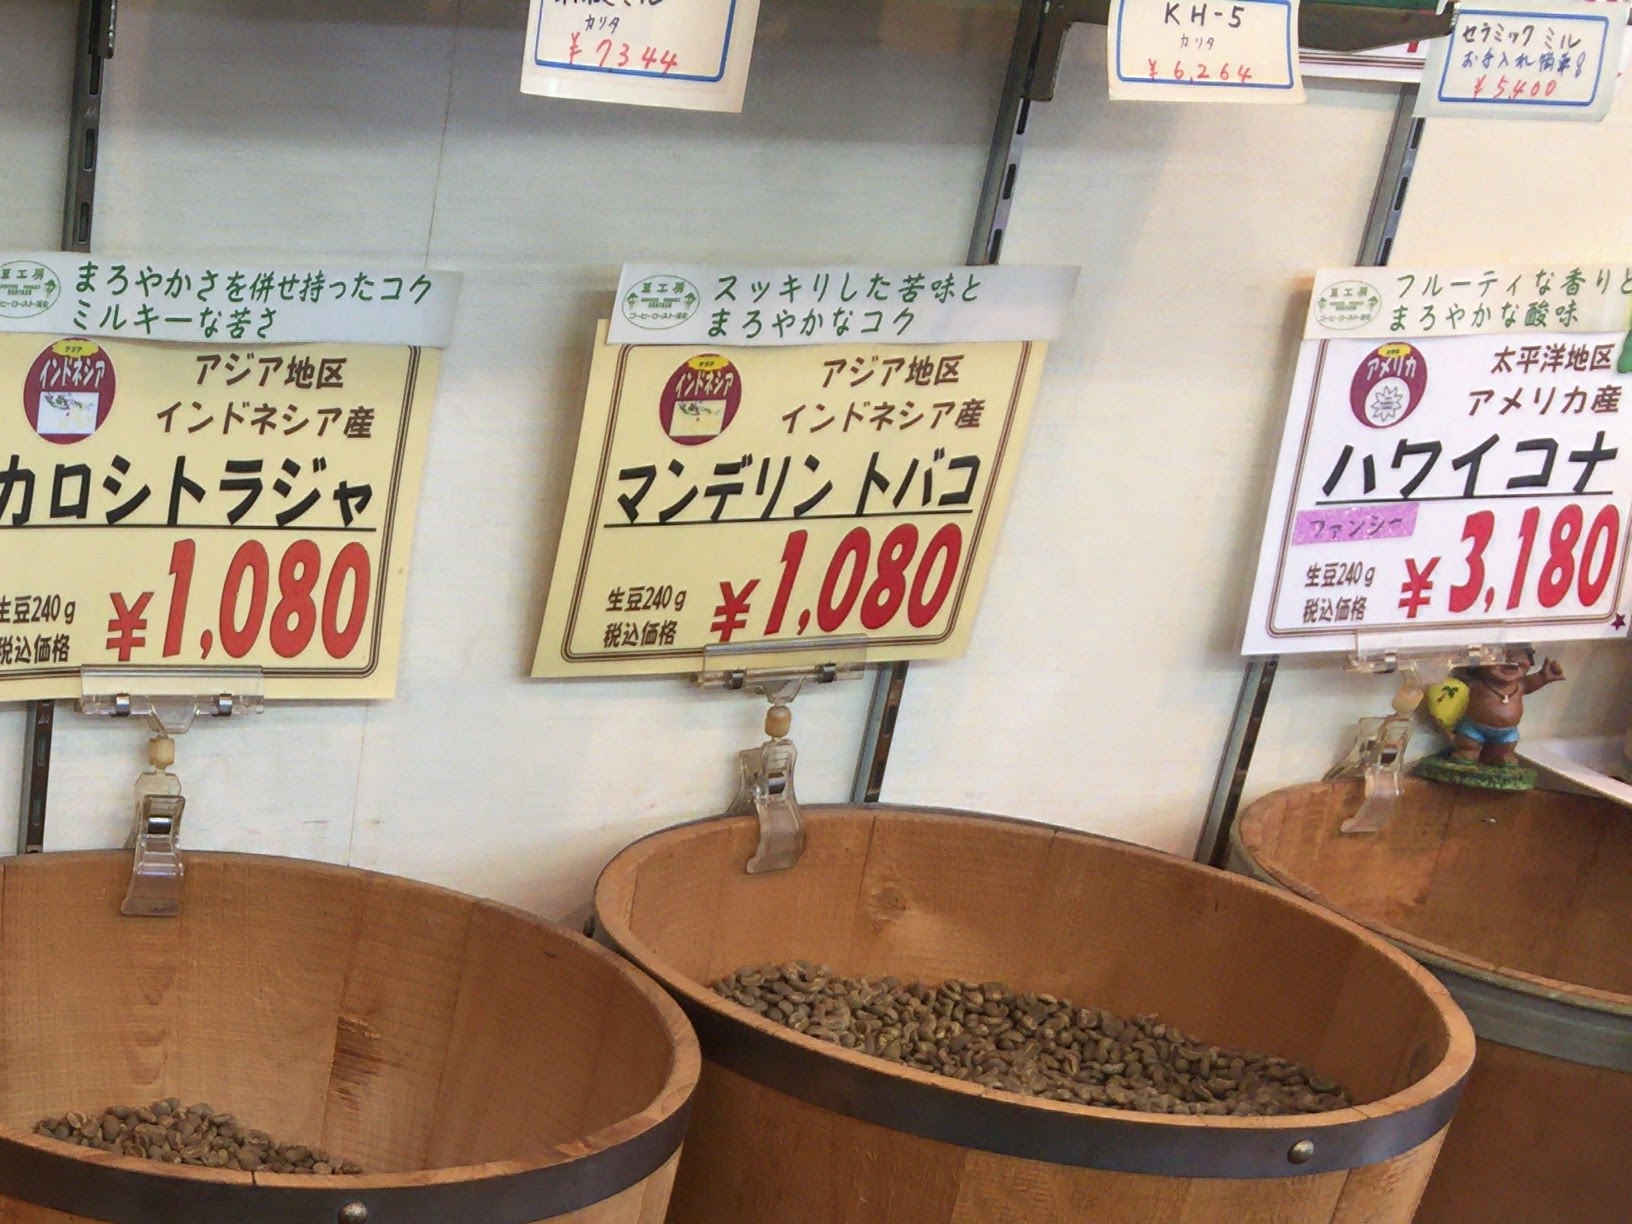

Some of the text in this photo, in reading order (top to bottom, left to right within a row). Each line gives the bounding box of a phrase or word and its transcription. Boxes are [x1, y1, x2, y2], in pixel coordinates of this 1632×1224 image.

[585, 14, 620, 34] カリタ
[1164, 2, 1245, 28] KH-5
[1179, 33, 1215, 50] カリタ
[1462, 22, 1534, 46] セラミック
[75, 260, 432, 303] まろやかさを併せ持ったコク
[714, 274, 981, 303] スッキリした苦味と
[72, 299, 278, 338] ミルキーな苦さ
[709, 307, 914, 338] まろやかなコク
[1390, 299, 1579, 332] まろやかな酸味
[40, 357, 105, 389] インドネシア
[195, 354, 347, 389] アジア地区
[822, 354, 964, 387] アジア地区
[1367, 356, 1417, 381] アメリカ
[1491, 343, 1616, 375] 太平洋地区
[676, 371, 734, 399] インドネシア
[1469, 385, 1622, 417] アメリカ産
[156, 401, 374, 439] インドネシア産
[781, 398, 985, 434] インドネシア産
[1322, 430, 1618, 499] ハワイコナ
[1309, 515, 1403, 540] ファンシー
[1398, 503, 1620, 619] ¥3,180
[709, 522, 962, 642] ¥1,080
[106, 538, 370, 662] ¥1,080
[1302, 597, 1367, 624] 税込価格
[603, 620, 677, 648] 税込価格
